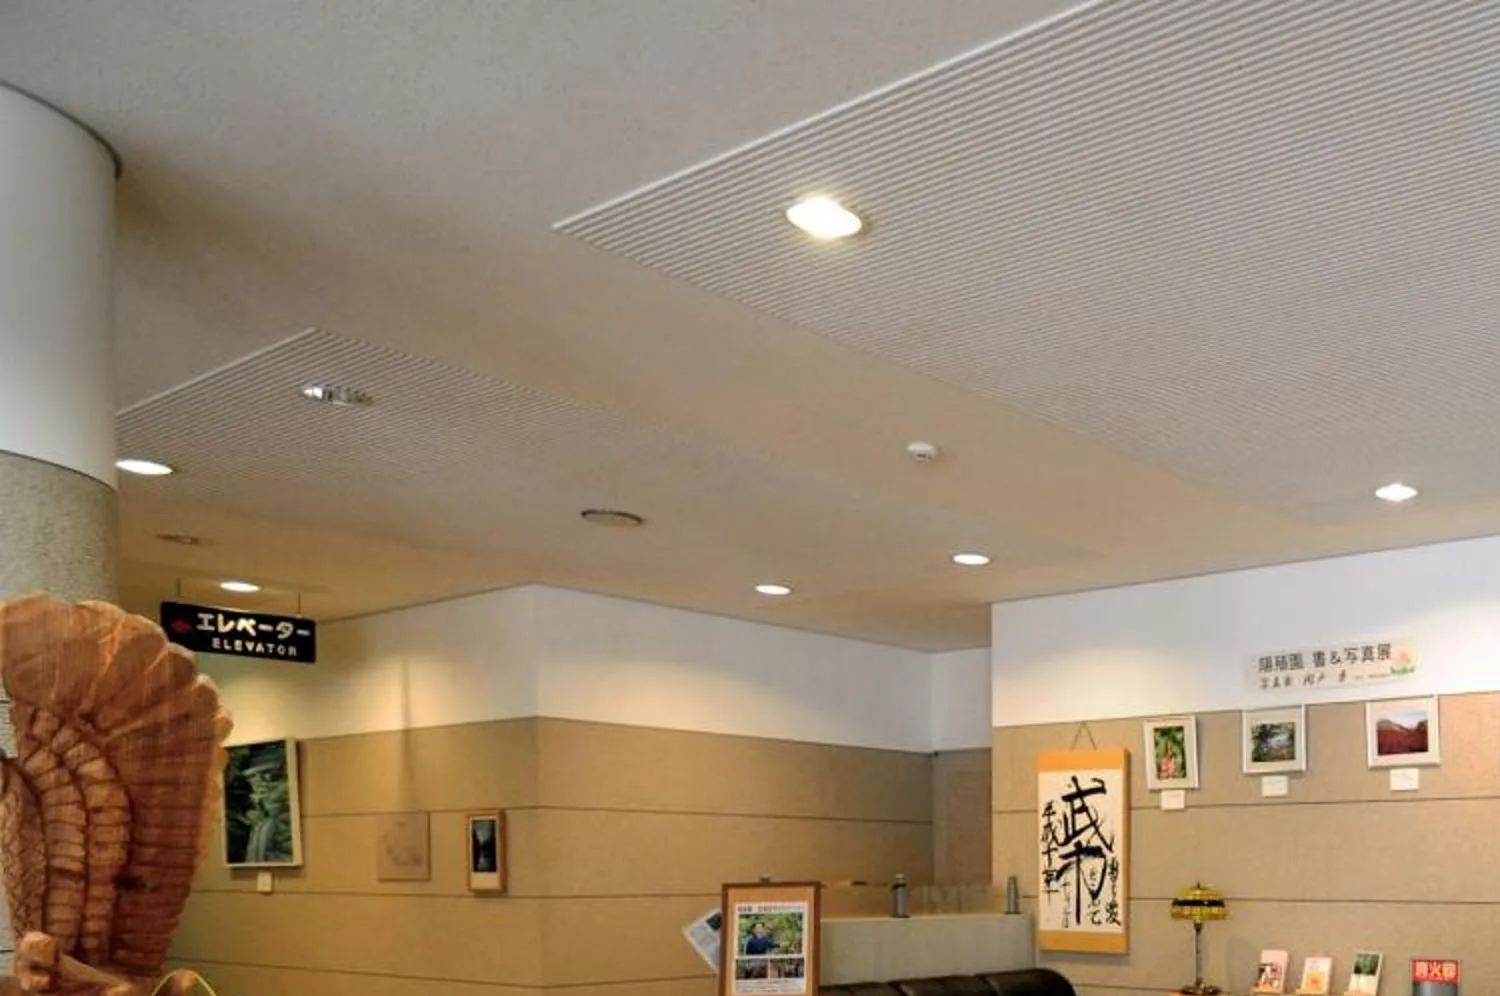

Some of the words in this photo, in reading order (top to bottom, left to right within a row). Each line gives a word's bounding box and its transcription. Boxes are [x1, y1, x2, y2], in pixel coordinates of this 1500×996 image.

[196, 612, 311, 640] エレベーター
[211, 637, 297, 657] ELEVATOR
